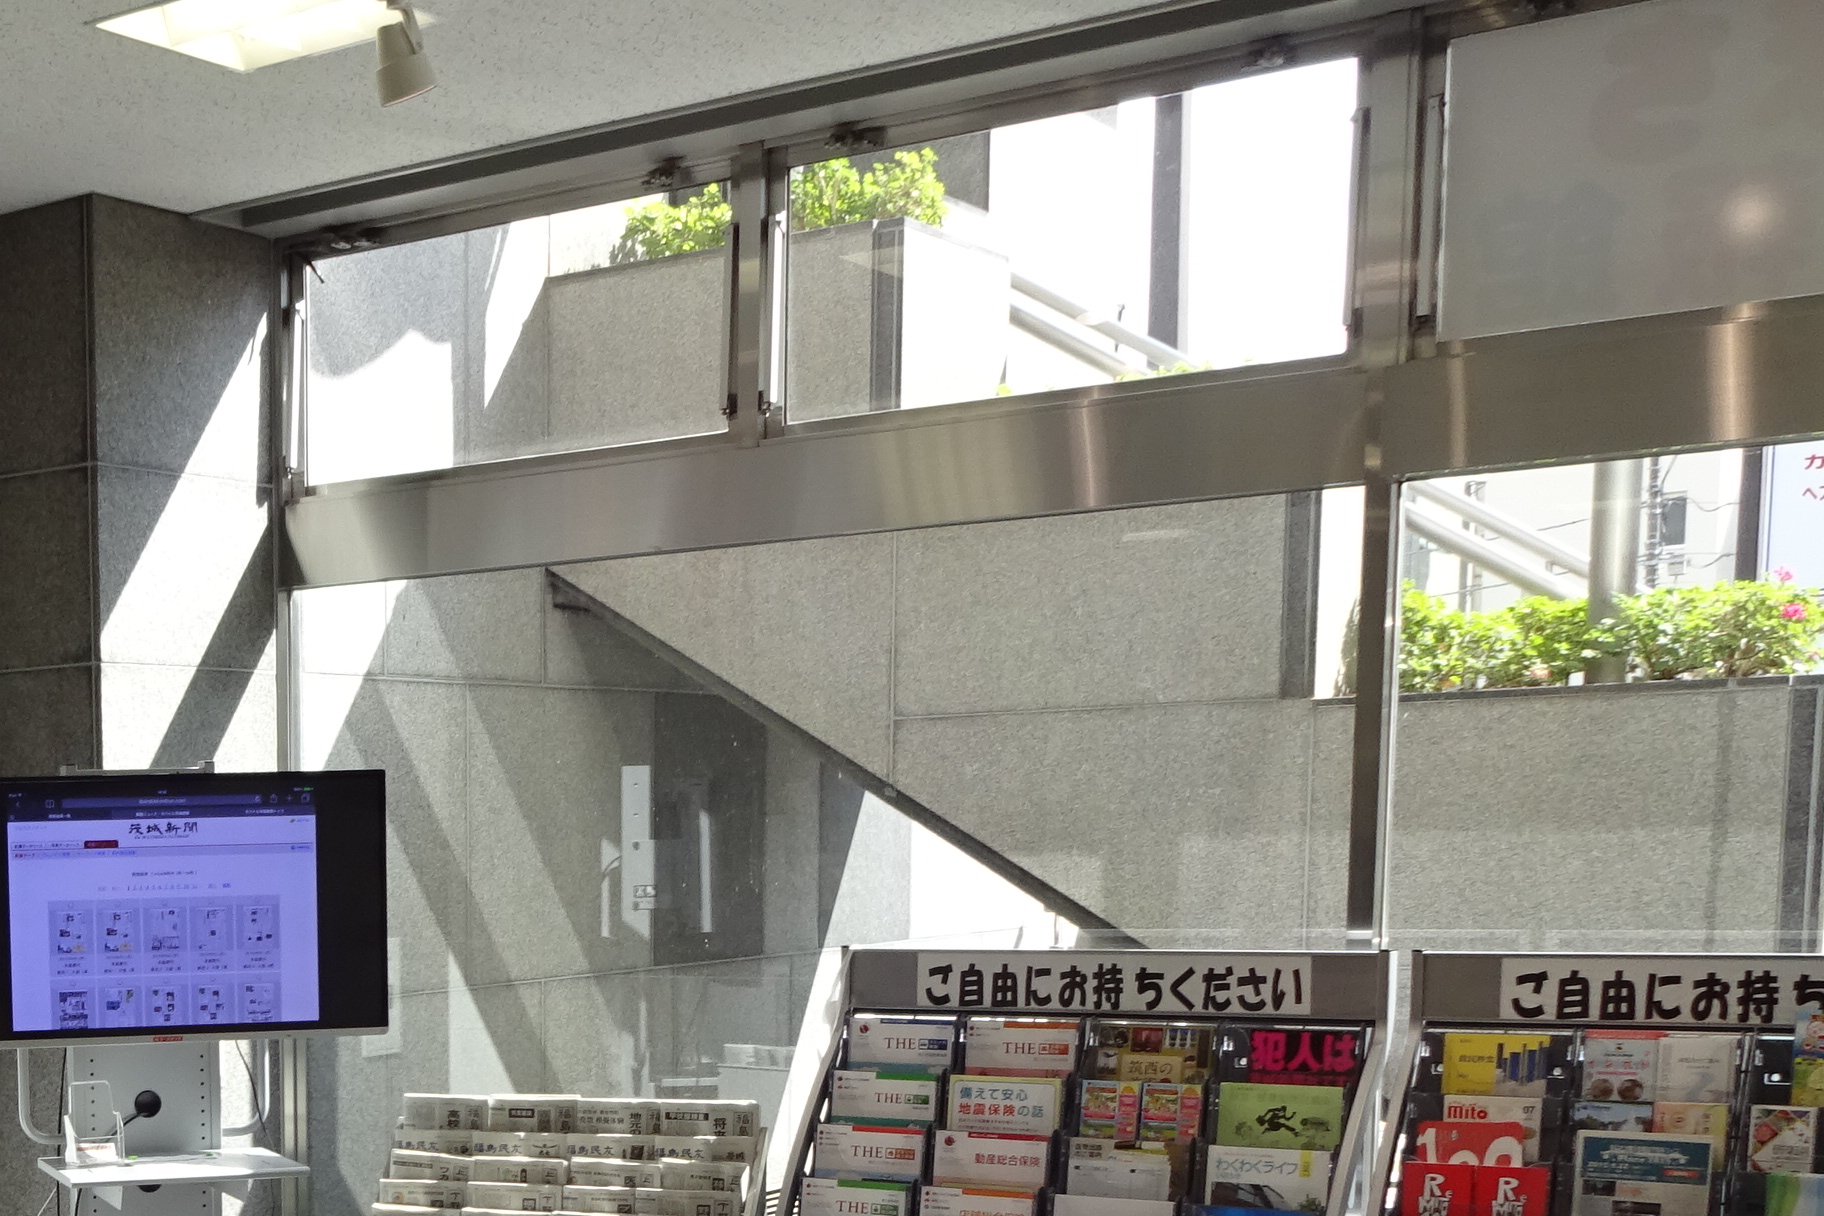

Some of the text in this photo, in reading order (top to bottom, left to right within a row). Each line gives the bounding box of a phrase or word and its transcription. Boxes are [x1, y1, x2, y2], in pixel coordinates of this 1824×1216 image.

[128, 821, 198, 835] 茨城新聞
[924, 964, 1304, 1011] ご自由にお持ちください
[884, 1037, 916, 1050] THE
[1002, 1042, 1037, 1055] THE
[1250, 1030, 1356, 1072] 犯人は
[875, 1092, 903, 1105] THE
[960, 1087, 1028, 1102] 備えて安心
[958, 1103, 1044, 1118] 地震保険の話
[851, 1145, 884, 1158] THE
[975, 1152, 1041, 1167] 動産総合保険
[1215, 1157, 1299, 1175] わくわくライフ
[835, 1200, 869, 1214] THE
